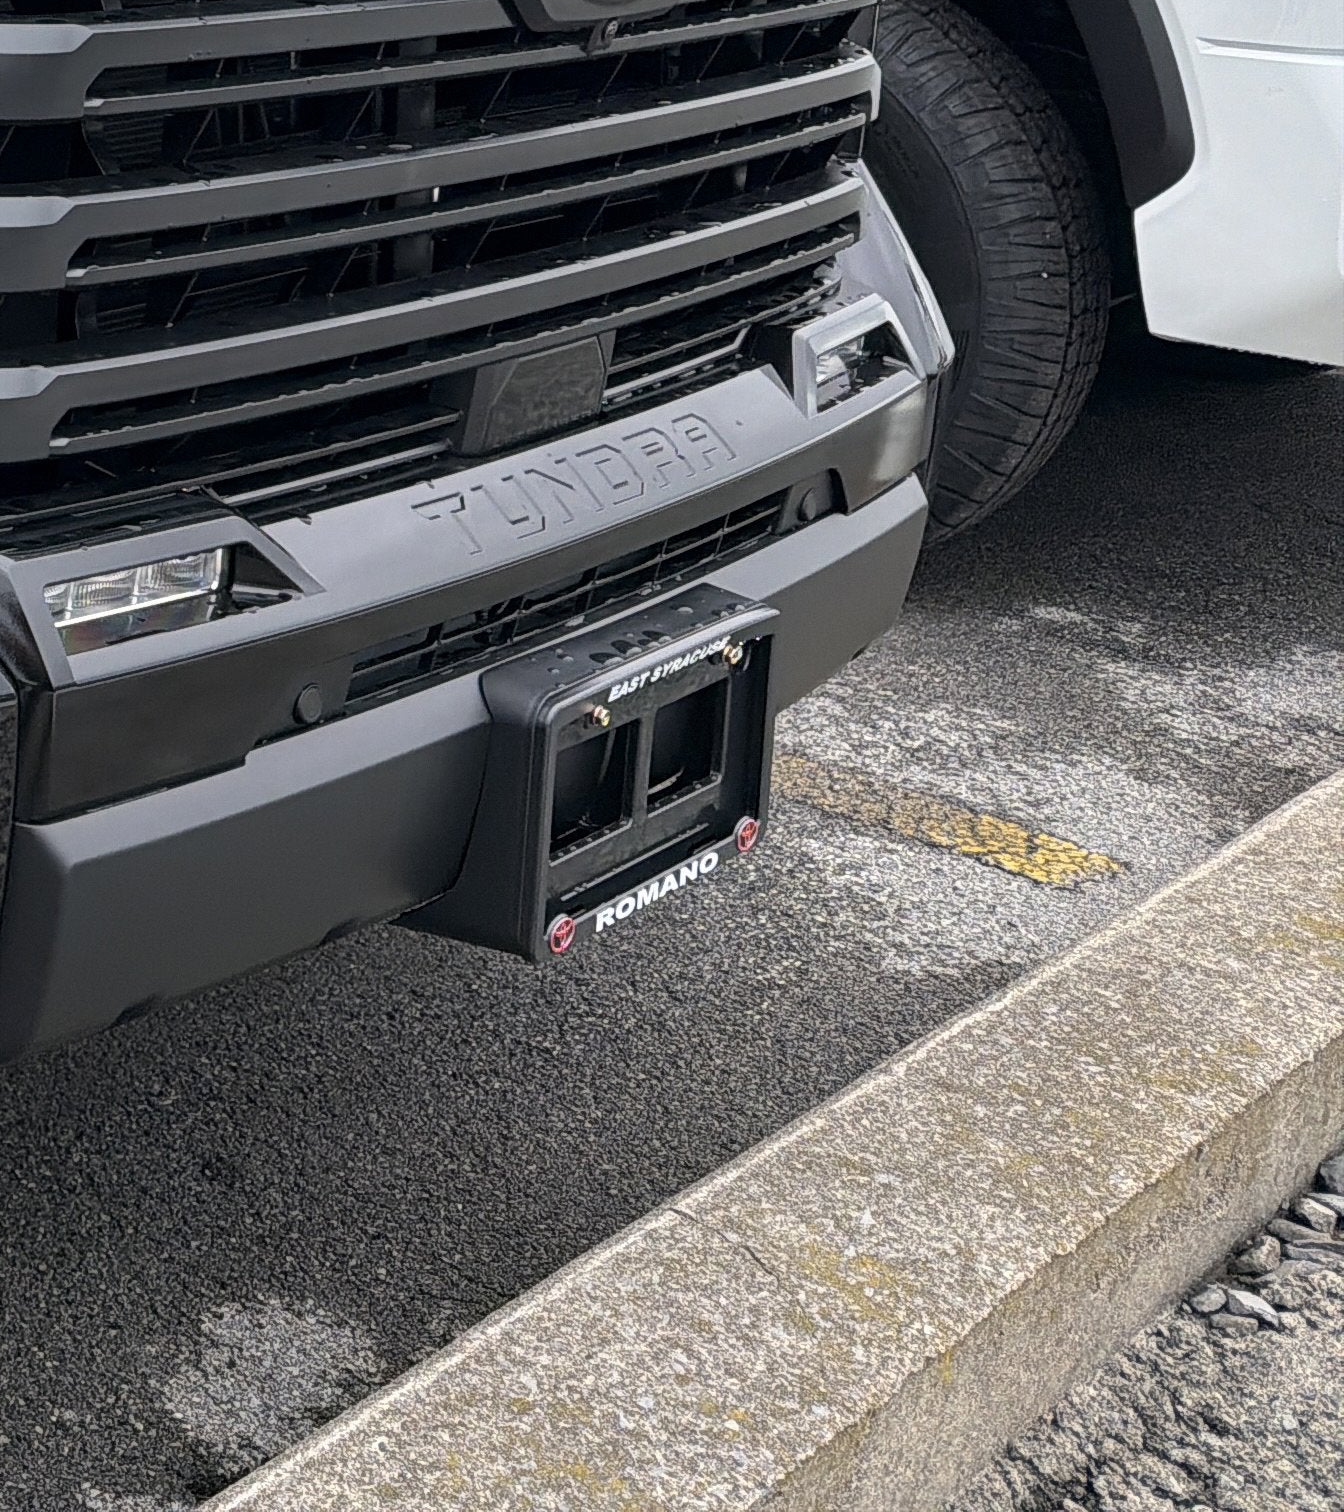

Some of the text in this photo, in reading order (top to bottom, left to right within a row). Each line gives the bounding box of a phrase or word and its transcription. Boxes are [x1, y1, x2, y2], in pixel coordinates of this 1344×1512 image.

[410, 412, 737, 556] TUNDRA
[607, 635, 732, 703] EAST SYRACUSE
[594, 851, 720, 933] ROMANO
